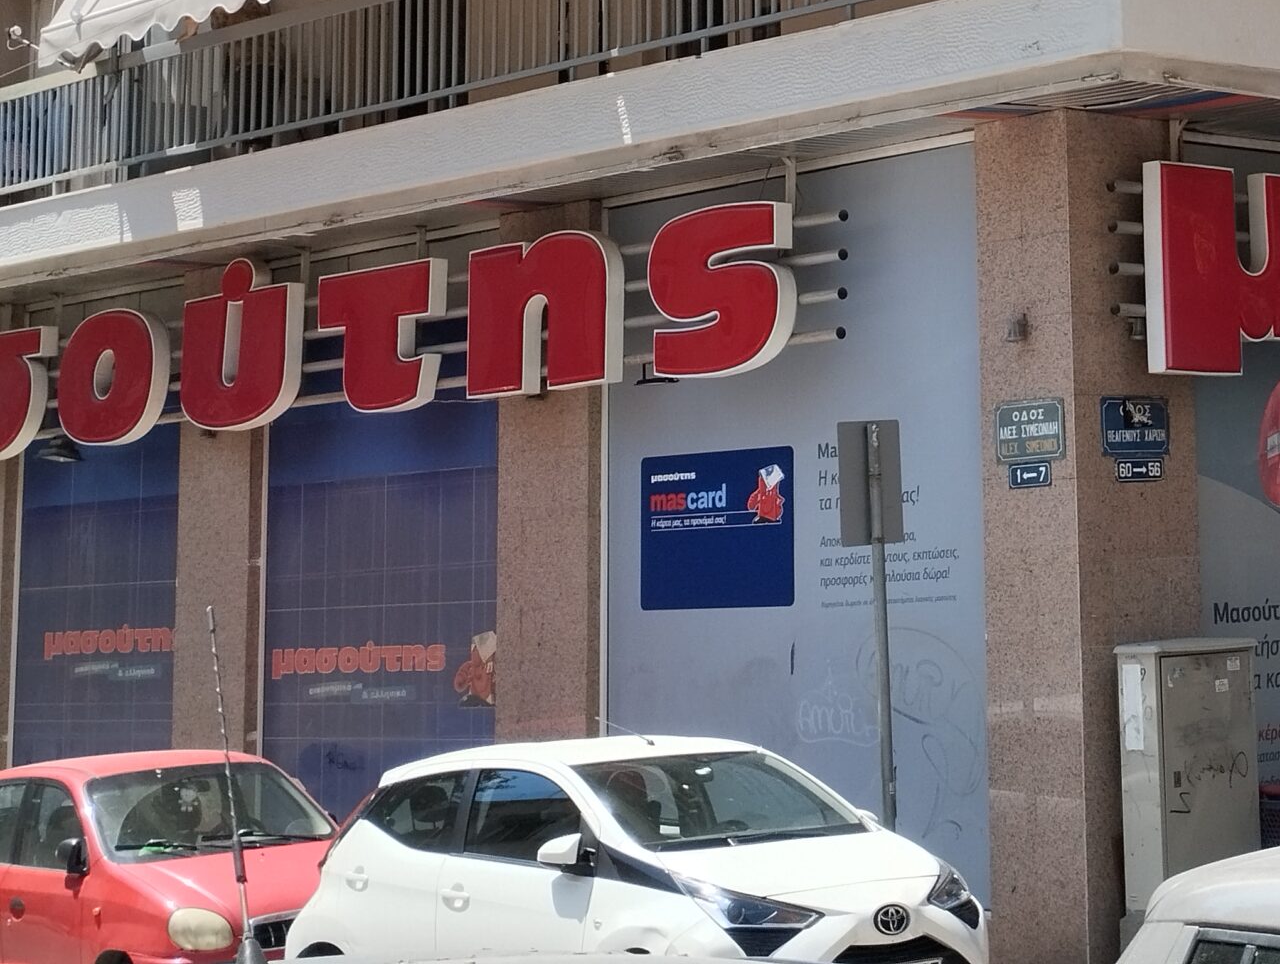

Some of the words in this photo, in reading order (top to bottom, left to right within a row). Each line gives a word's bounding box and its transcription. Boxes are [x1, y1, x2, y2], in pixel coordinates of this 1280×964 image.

[1012, 409, 1045, 422] ΟΔΟΣ
[651, 471, 697, 484] μασούτης
[1016, 469, 1021, 483] 1
[1039, 467, 1046, 482] 7
[1119, 463, 1132, 477] 60
[1148, 462, 1160, 476] 56
[650, 483, 727, 512] mascard
[902, 485, 920, 506] ας!
[820, 556, 833, 568] και
[835, 552, 871, 569] κερδίστε
[884, 550, 910, 563] ντους,
[913, 547, 960, 561] εκπτώσεις,
[820, 573, 867, 589] προσφορές
[922, 567, 950, 583] δώρα!
[271, 640, 446, 680] μασούτης
